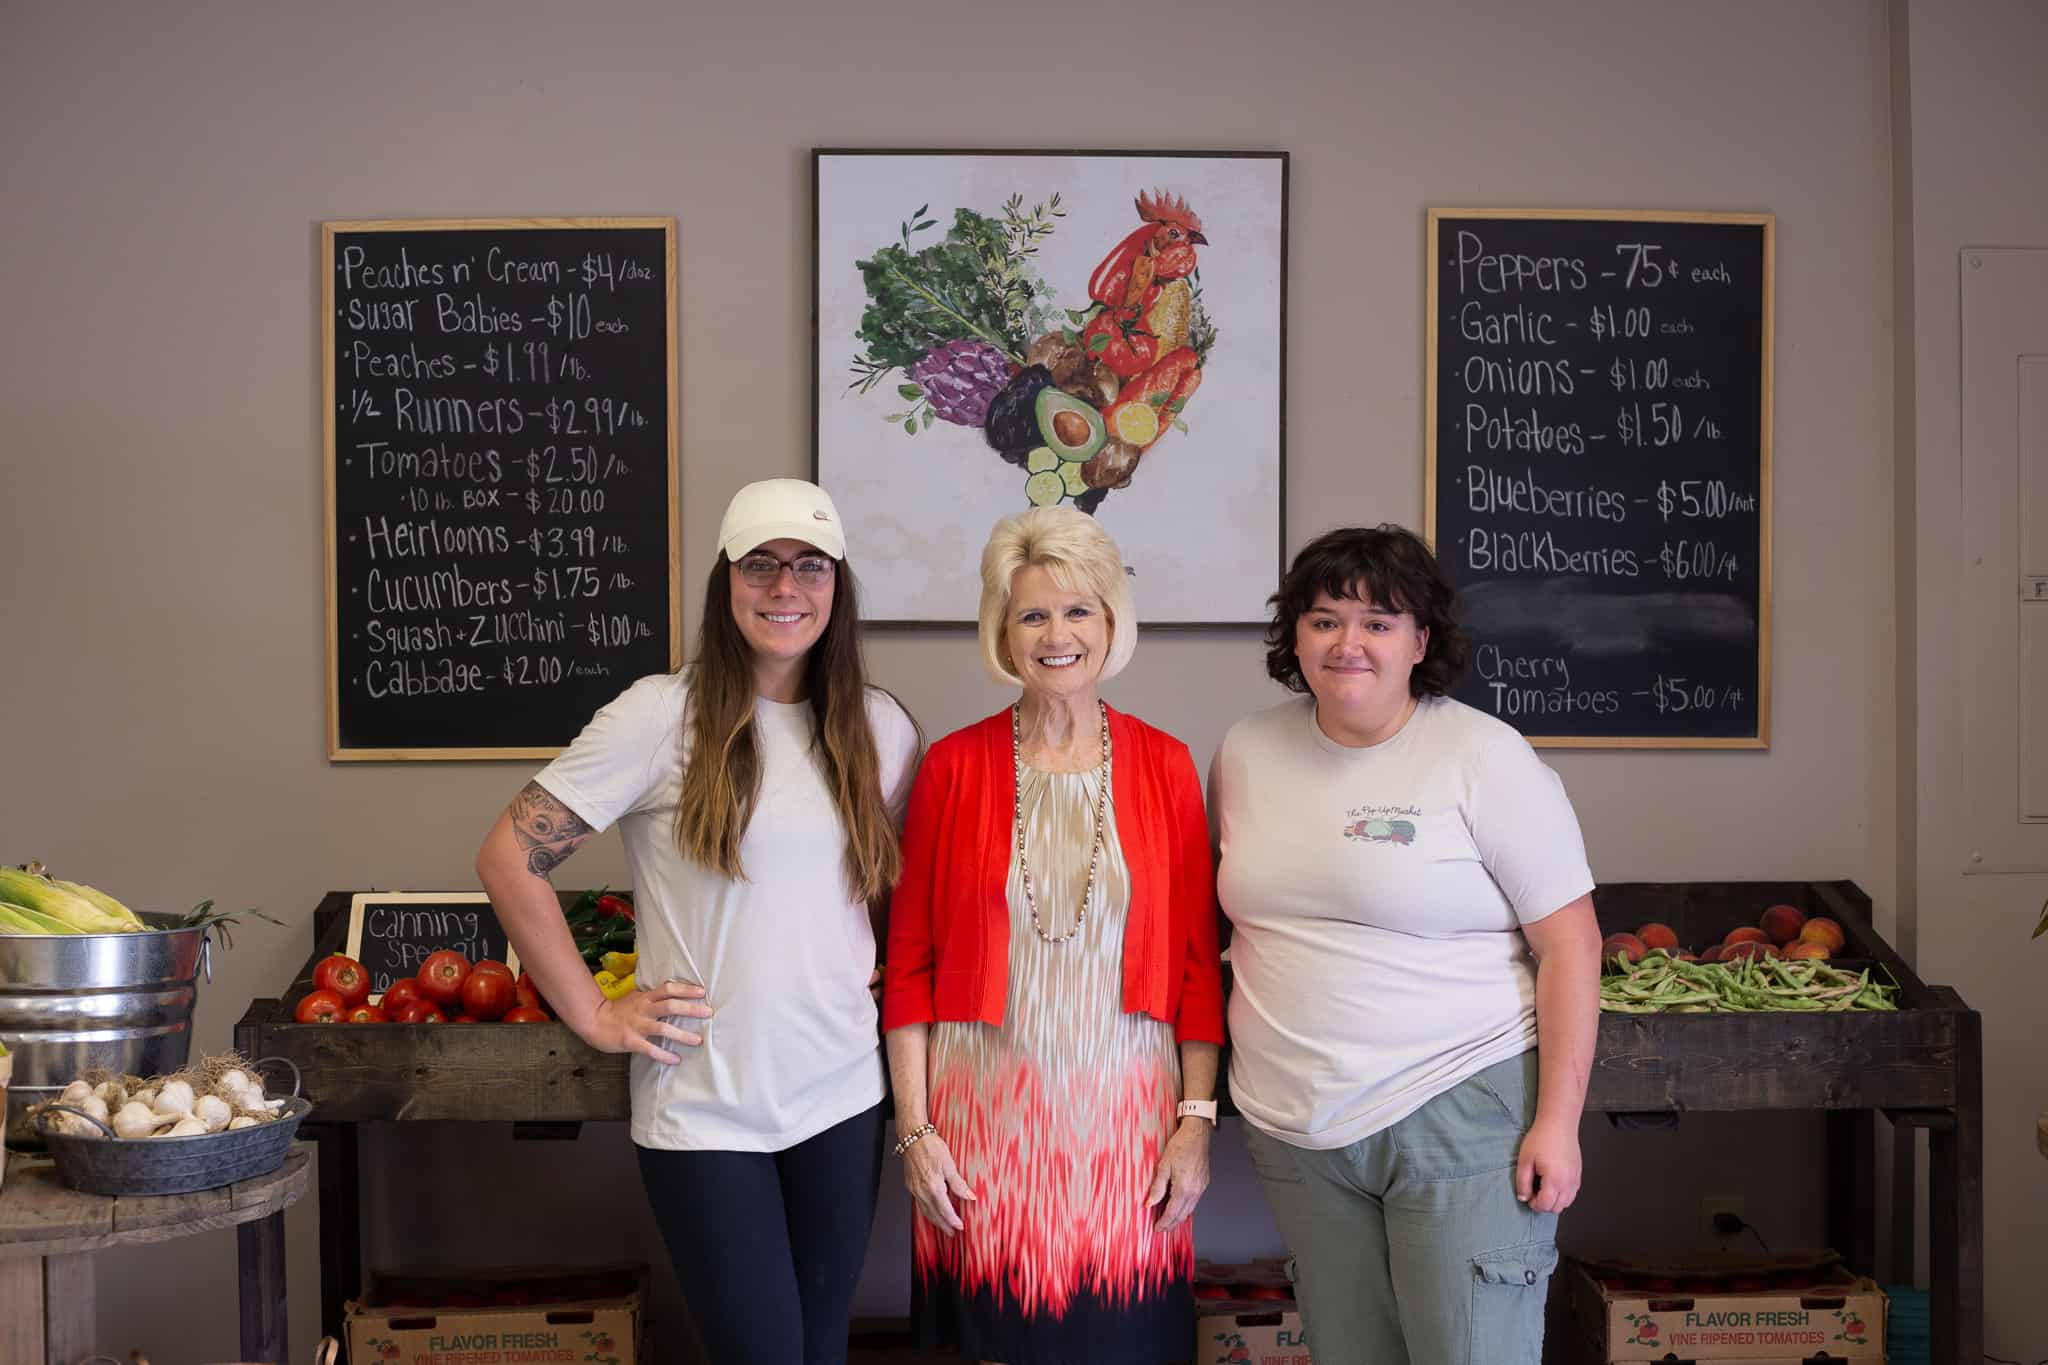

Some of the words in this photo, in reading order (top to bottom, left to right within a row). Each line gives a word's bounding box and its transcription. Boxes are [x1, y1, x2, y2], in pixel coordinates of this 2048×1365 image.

[344, 246, 444, 289] Peaches
[488, 247, 559, 284] Cream
[1459, 230, 1586, 294] Peppers
[1691, 264, 1731, 284] each
[349, 298, 419, 331] Sugar
[437, 293, 522, 333] Babies
[596, 318, 629, 333] each
[1461, 301, 1556, 345] Garlic
[1660, 322, 1693, 334] each
[353, 341, 455, 379] Peaches
[1464, 356, 1574, 395] Onions
[1672, 370, 1710, 389] each
[395, 388, 523, 434] Runners
[1467, 404, 1584, 454] Potatoes
[356, 442, 502, 483] Tomatoes
[409, 488, 428, 512] 10
[464, 490, 500, 509] BOX
[1467, 465, 1625, 521] Blueberries
[366, 516, 508, 560] Heirlooms
[1469, 528, 1639, 576] Blackberries
[368, 564, 512, 613] Cucumbers
[368, 618, 451, 656] Squash
[366, 658, 485, 699] Cabbage
[1477, 644, 1568, 690] Cherry
[1489, 681, 1619, 715] Tomatoes
[369, 908, 478, 942] Canning
[1670, 1333, 1697, 1345] VINE
[1701, 1332, 1754, 1345] RIPENED
[1758, 1331, 1824, 1345] TOMATOES
[1686, 1312, 1750, 1327] FLAVOR
[1756, 1312, 1809, 1326] FRESH
[430, 1335, 497, 1351] FLAVOR
[502, 1332, 558, 1349] FRESH
[504, 1350, 575, 1362] TOMATOES
